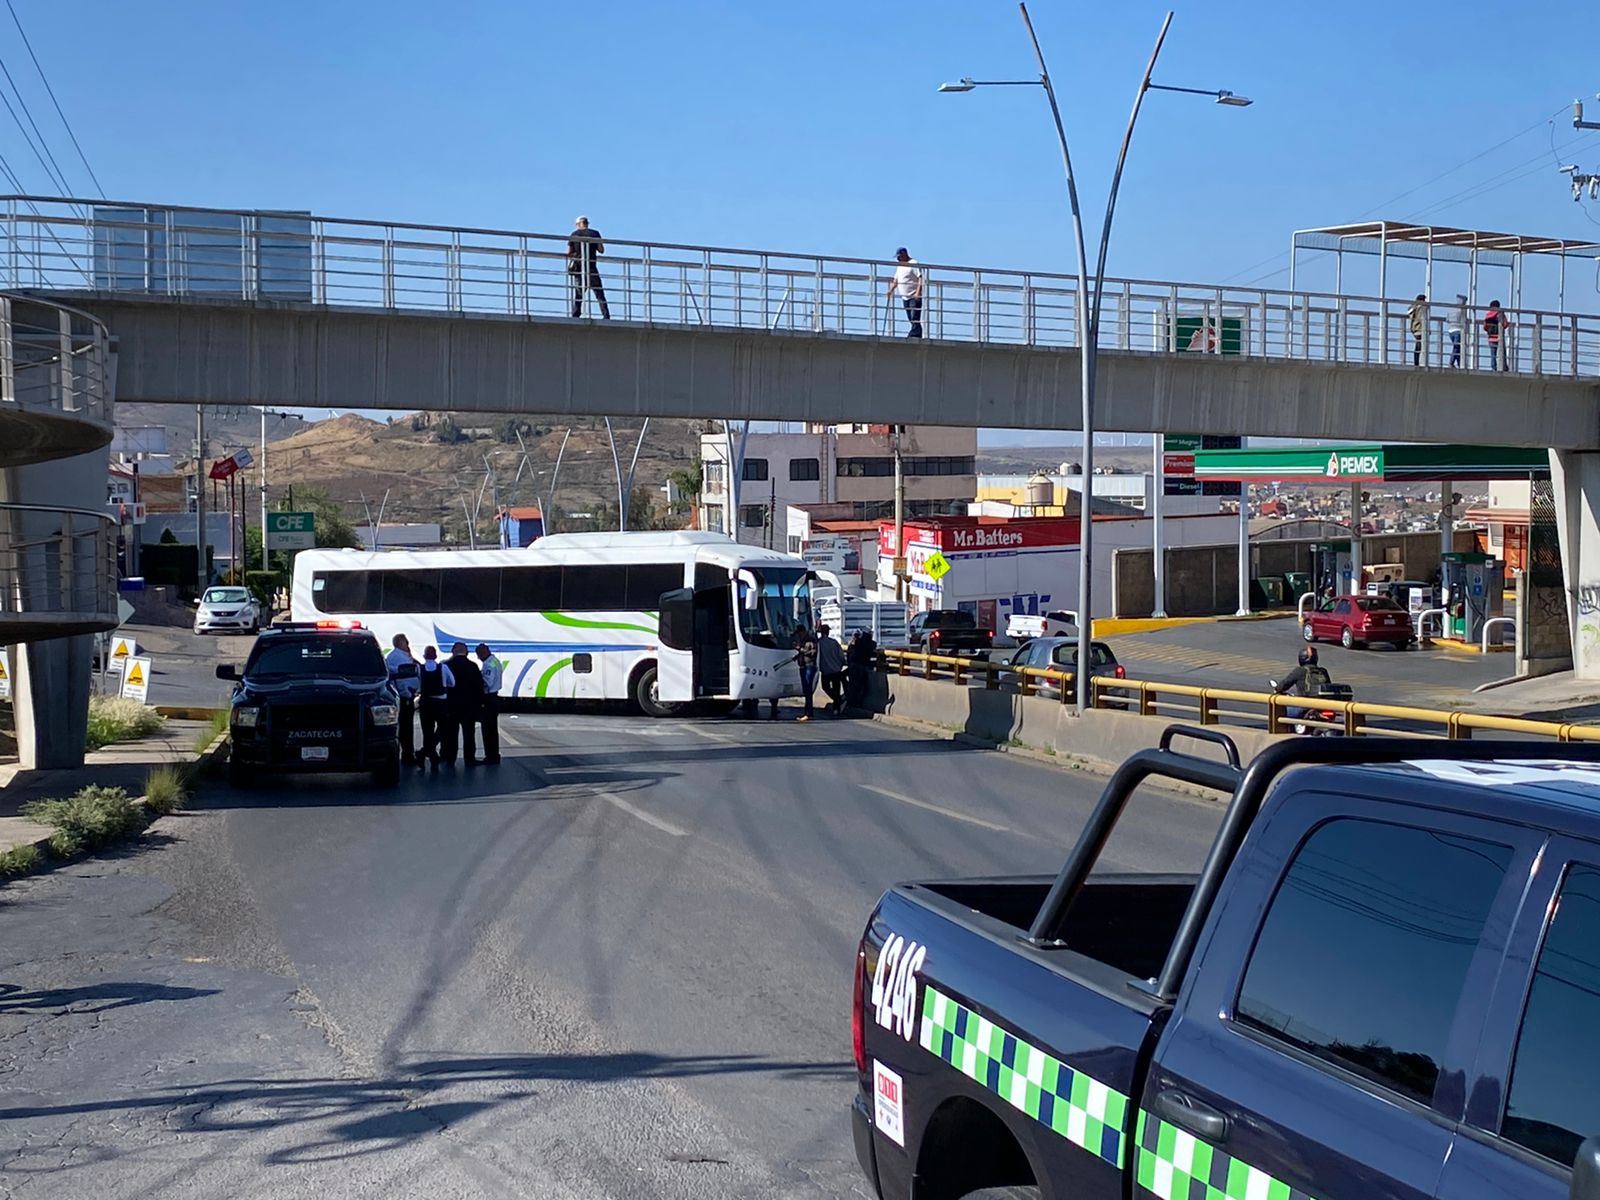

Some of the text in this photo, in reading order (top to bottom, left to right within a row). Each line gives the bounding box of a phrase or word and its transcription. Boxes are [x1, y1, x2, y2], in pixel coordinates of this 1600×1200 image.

[1340, 456, 1378, 473] PEMEX
[276, 515, 304, 529] CFE
[288, 730, 343, 738] ZACATECAS
[871, 932, 927, 1042] 4246
